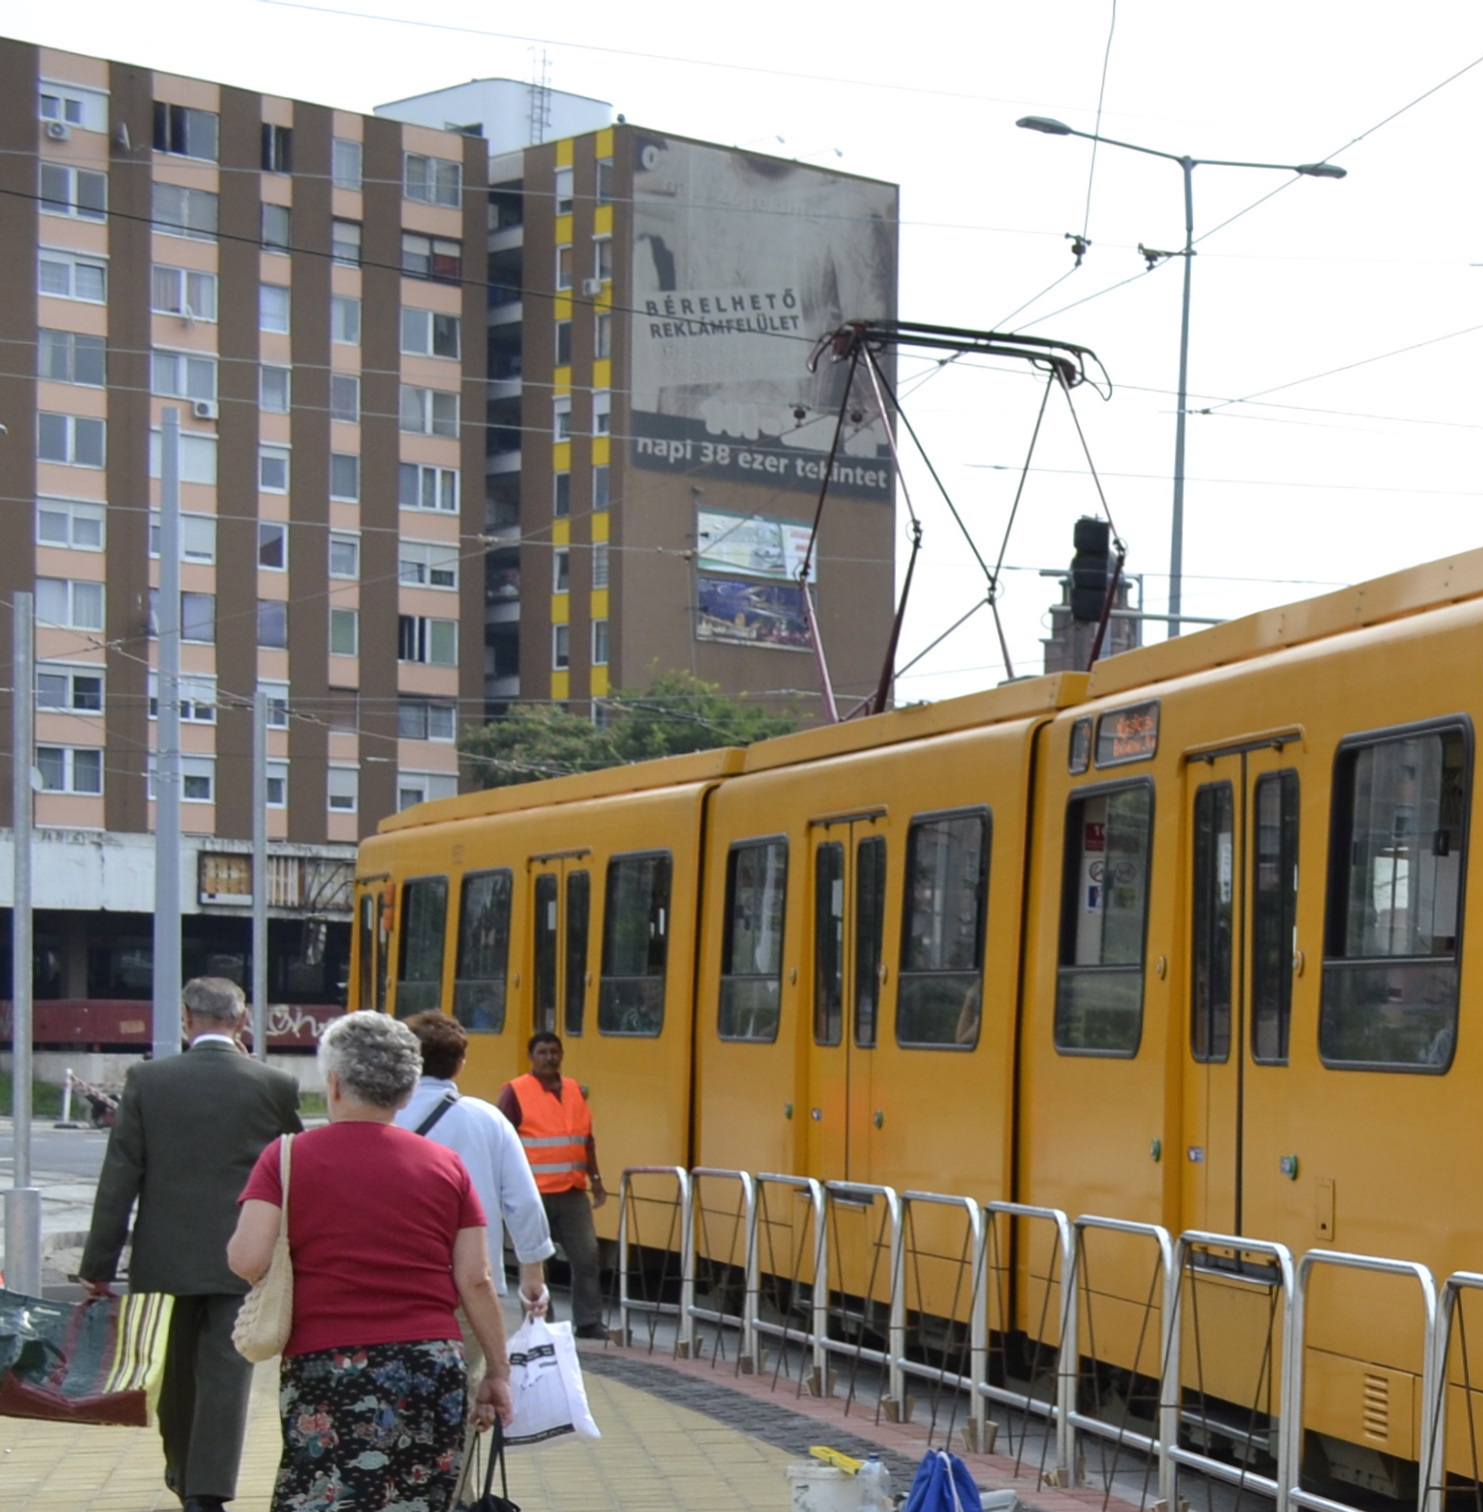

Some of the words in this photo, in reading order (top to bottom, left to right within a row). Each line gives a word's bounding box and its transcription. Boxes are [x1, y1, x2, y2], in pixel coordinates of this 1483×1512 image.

[645, 288, 797, 317] BÉRELHETŐ
[649, 311, 801, 339] REKLÁMFELÜLET
[636, 436, 693, 465] napi
[699, 440, 731, 466] 38
[737, 451, 789, 475] ezer
[795, 457, 889, 490] tekintet
